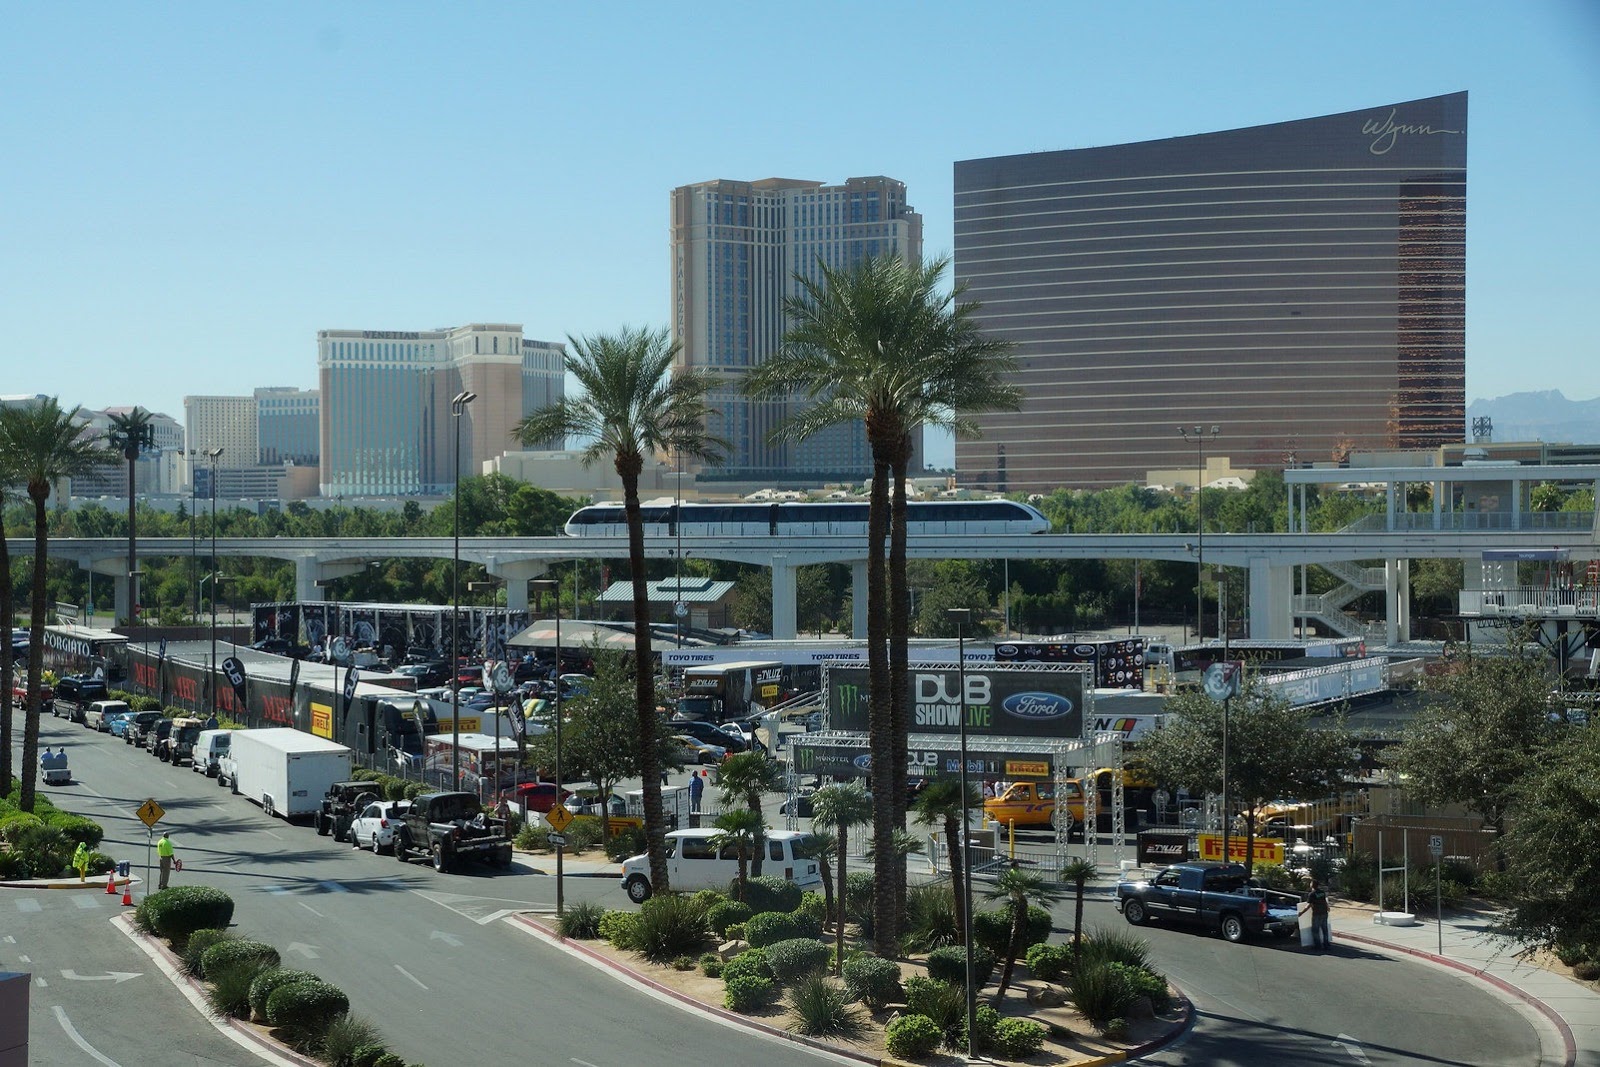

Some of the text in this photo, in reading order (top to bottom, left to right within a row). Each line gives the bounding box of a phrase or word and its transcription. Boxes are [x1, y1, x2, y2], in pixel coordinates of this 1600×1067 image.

[363, 331, 420, 340] VENETIAN
[43, 631, 90, 657] FORGIATO
[963, 653, 987, 661] TOYO
[1228, 650, 1282, 660] SAVINI
[222, 658, 243, 686] DUB
[344, 666, 359, 699] DUB
[915, 674, 991, 705] DUB
[1016, 695, 1058, 715] Ford
[915, 704, 961, 727] SHOW
[815, 755, 850, 763] MONSTER
[1431, 838, 1441, 847] 15
